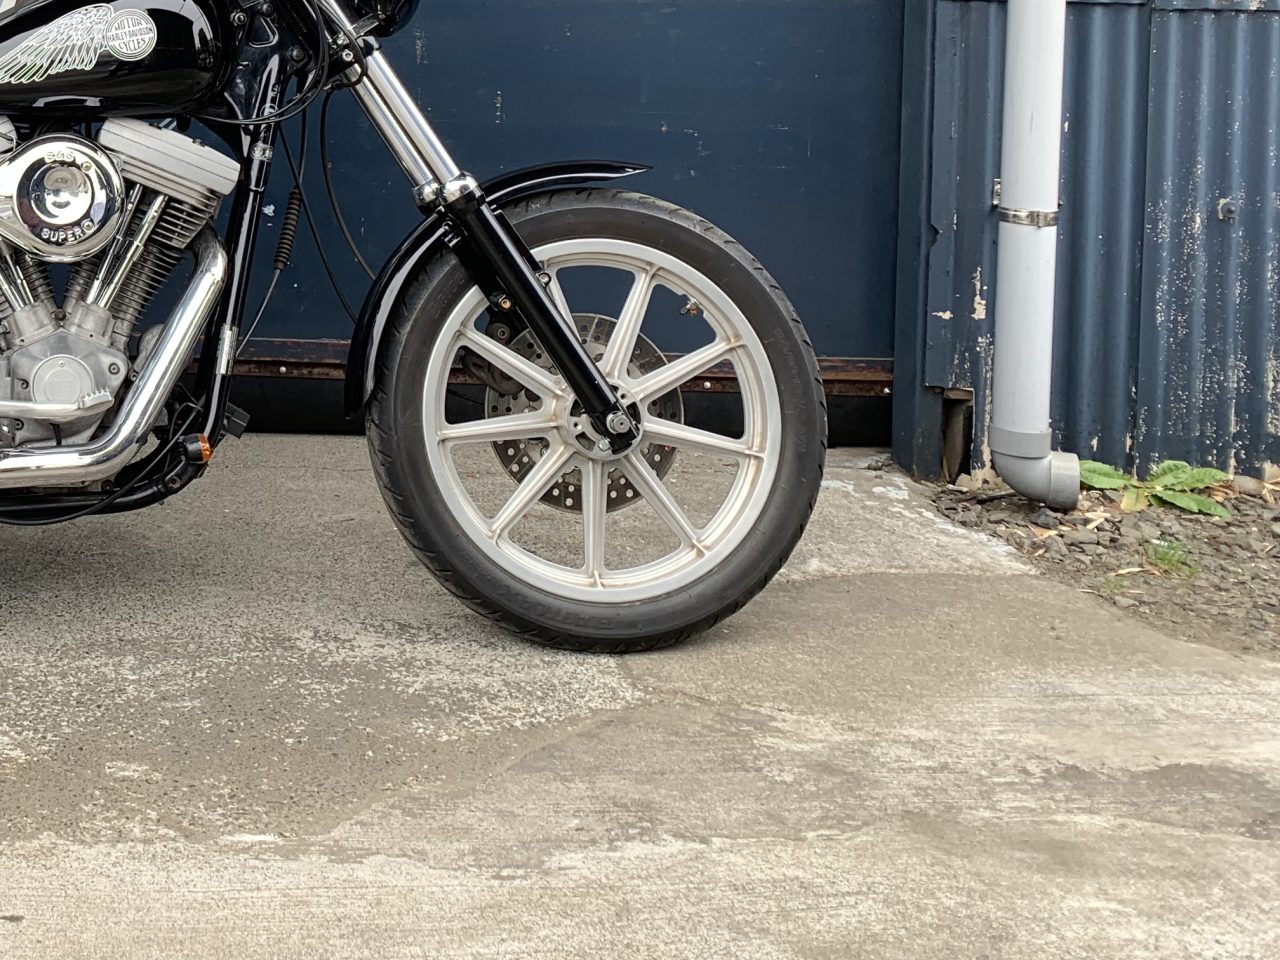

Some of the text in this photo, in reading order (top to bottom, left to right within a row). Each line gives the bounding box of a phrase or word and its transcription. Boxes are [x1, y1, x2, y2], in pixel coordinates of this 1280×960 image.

[114, 16, 143, 31] MOTOR
[118, 37, 146, 52] CYCLES
[41, 226, 84, 242] SUPER
